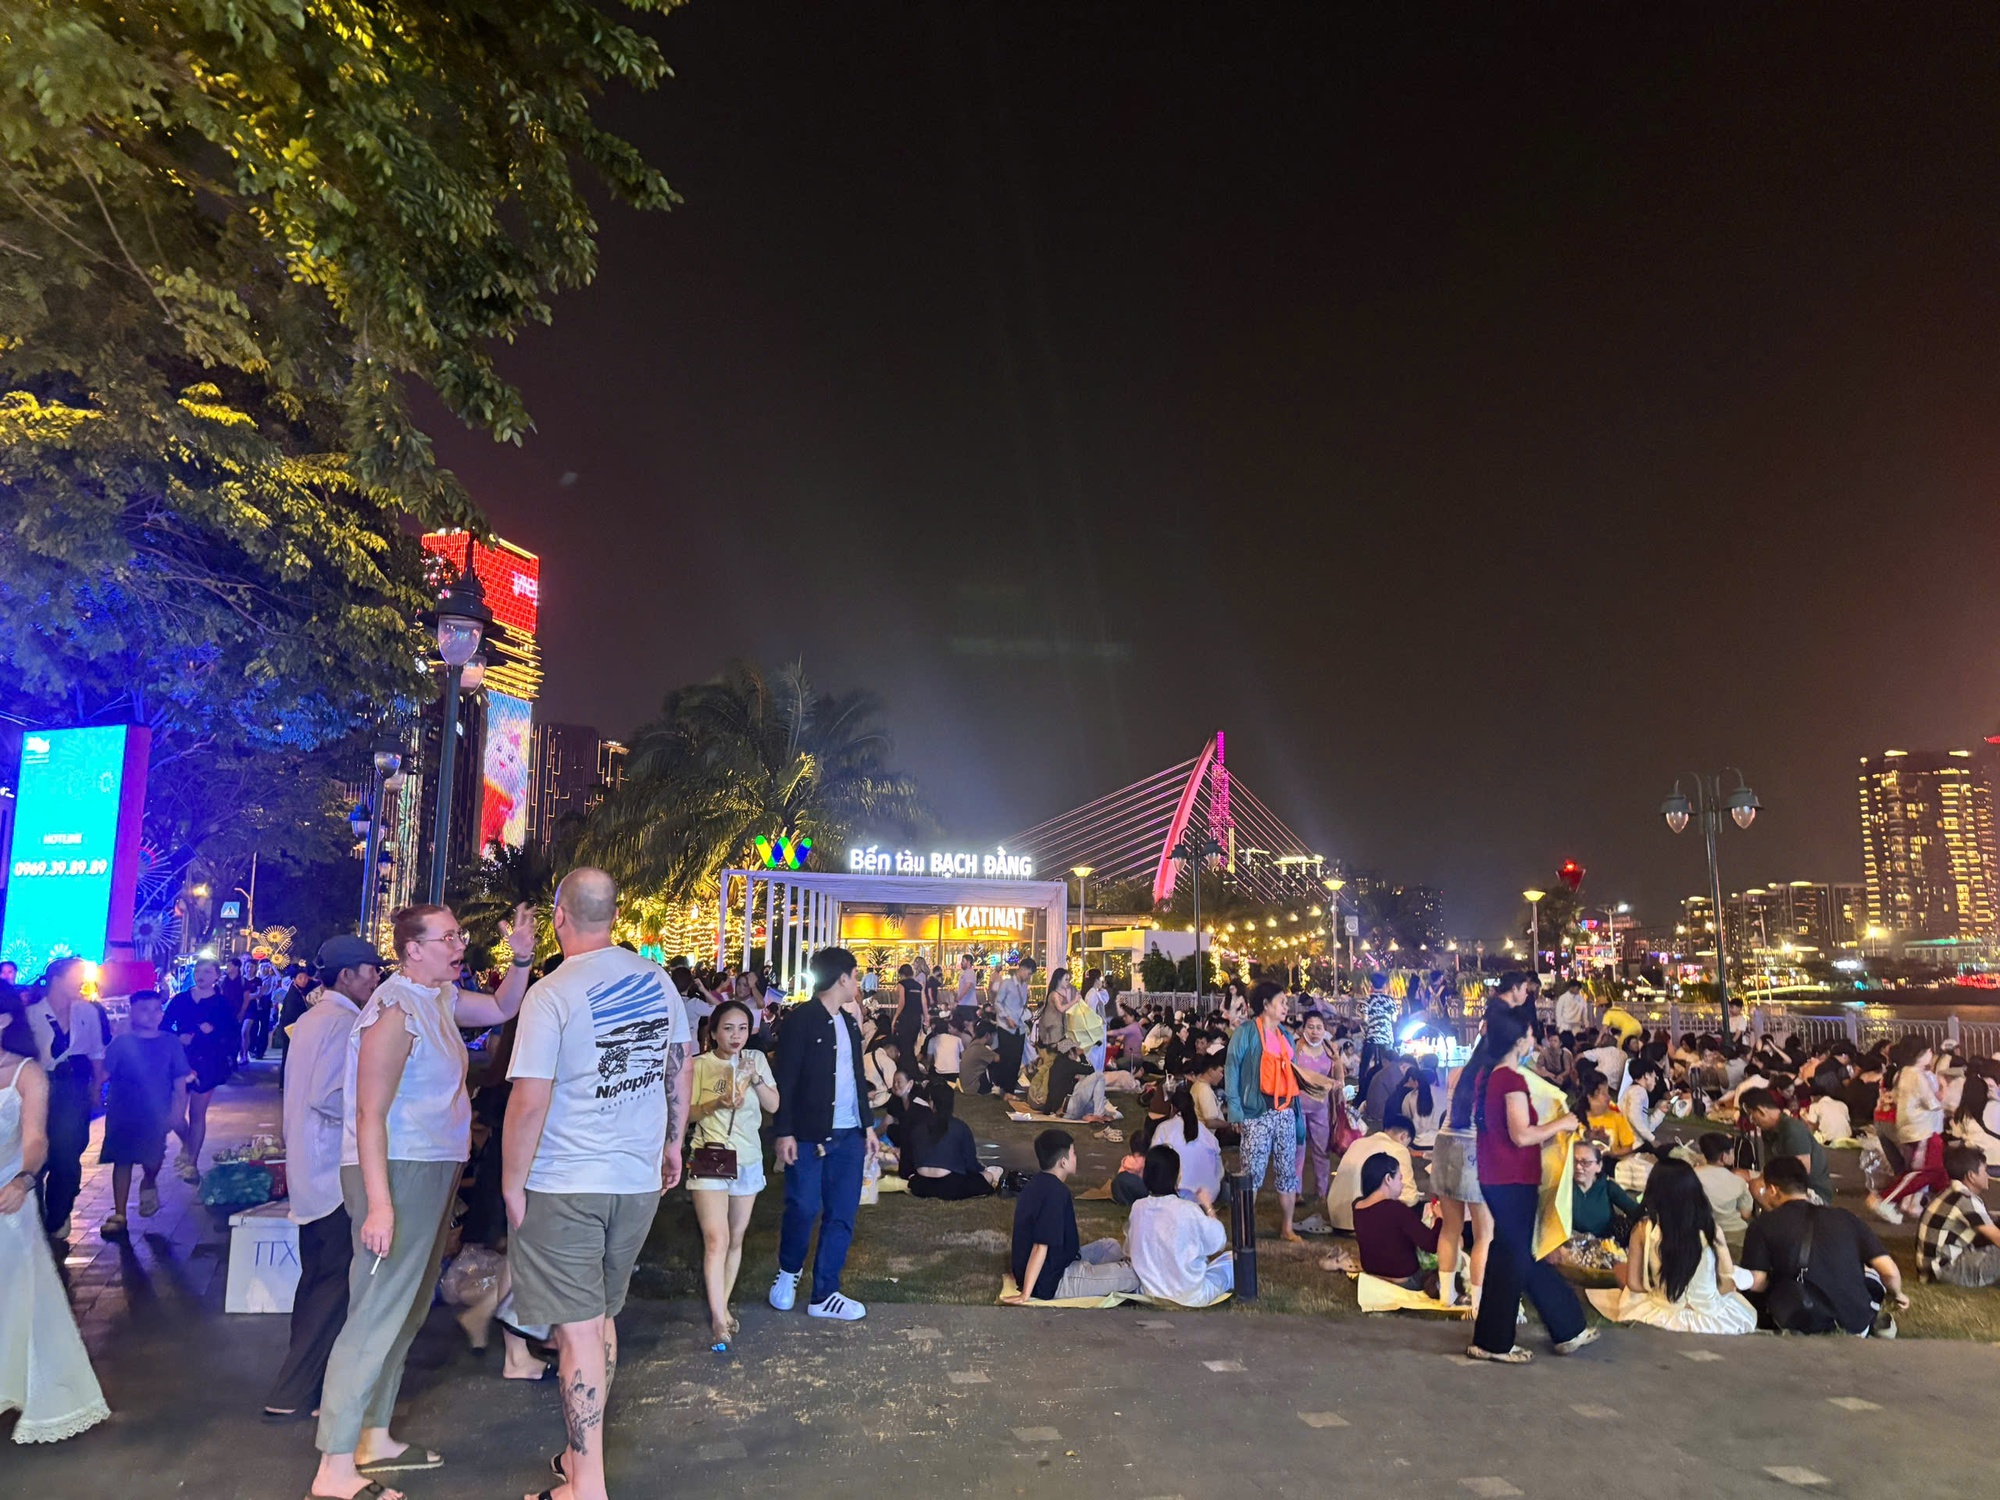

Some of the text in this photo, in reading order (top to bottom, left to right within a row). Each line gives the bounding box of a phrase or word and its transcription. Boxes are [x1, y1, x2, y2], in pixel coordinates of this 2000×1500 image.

[850, 844, 890, 871] Bến
[895, 849, 925, 872] tàu
[930, 852, 978, 878] BẠCH
[956, 905, 1026, 931] KATINAT
